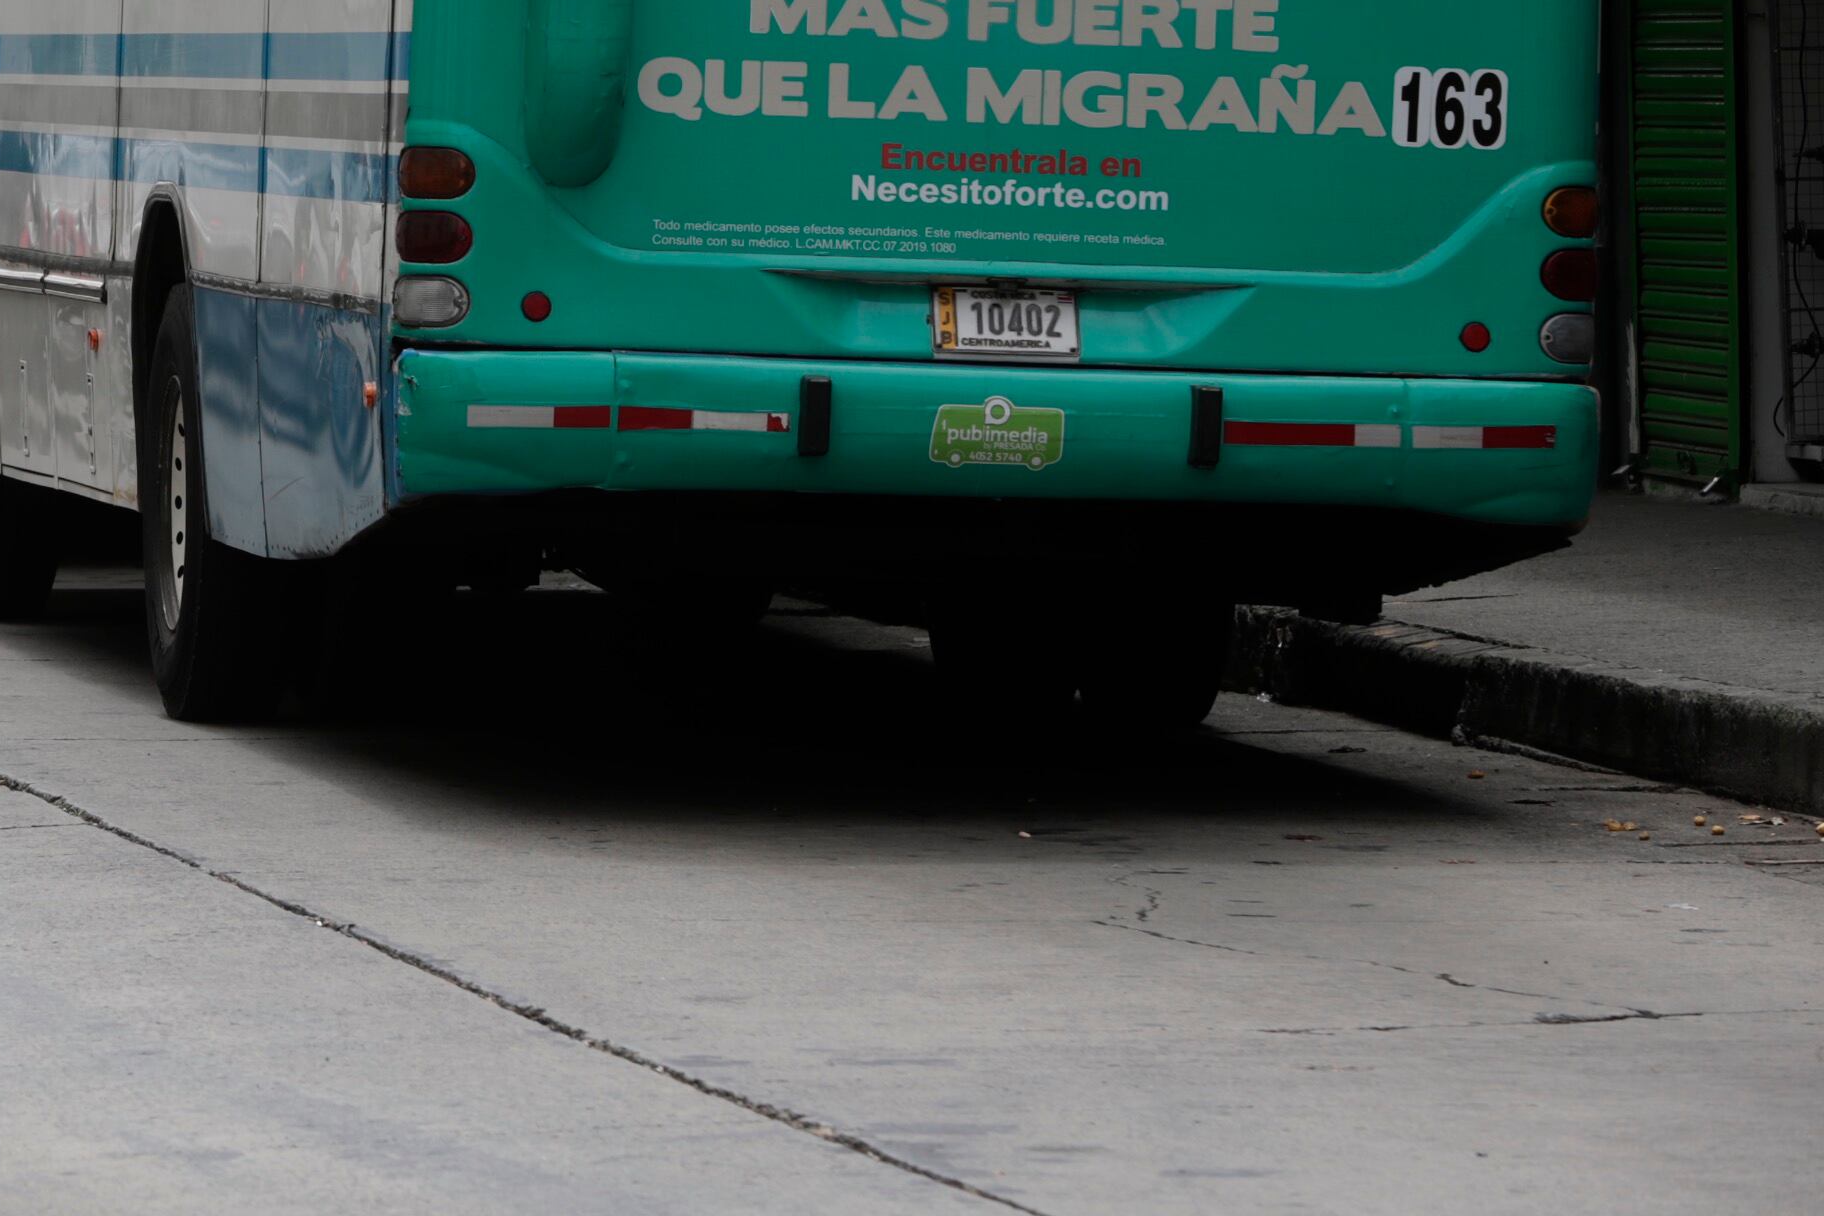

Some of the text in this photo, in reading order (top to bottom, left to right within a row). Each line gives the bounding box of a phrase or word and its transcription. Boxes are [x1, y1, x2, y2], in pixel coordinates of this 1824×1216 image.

[637, 56, 1388, 138] QUE LA MIGRAÑA
[1401, 71, 1503, 147] 163
[881, 142, 1142, 178] Encuentrala en
[851, 174, 1169, 211] Necesitoforte.com
[652, 234, 703, 246] Consulte
[706, 237, 726, 247] con
[731, 238, 744, 248] su
[749, 236, 793, 249] médico.
[653, 219, 1167, 247] Todo medicamento posee efectos secundarios. Este medicamento requiere receta médica.
[970, 301, 1063, 339] 10402
[961, 337, 1051, 349] CENTROAMERICA
